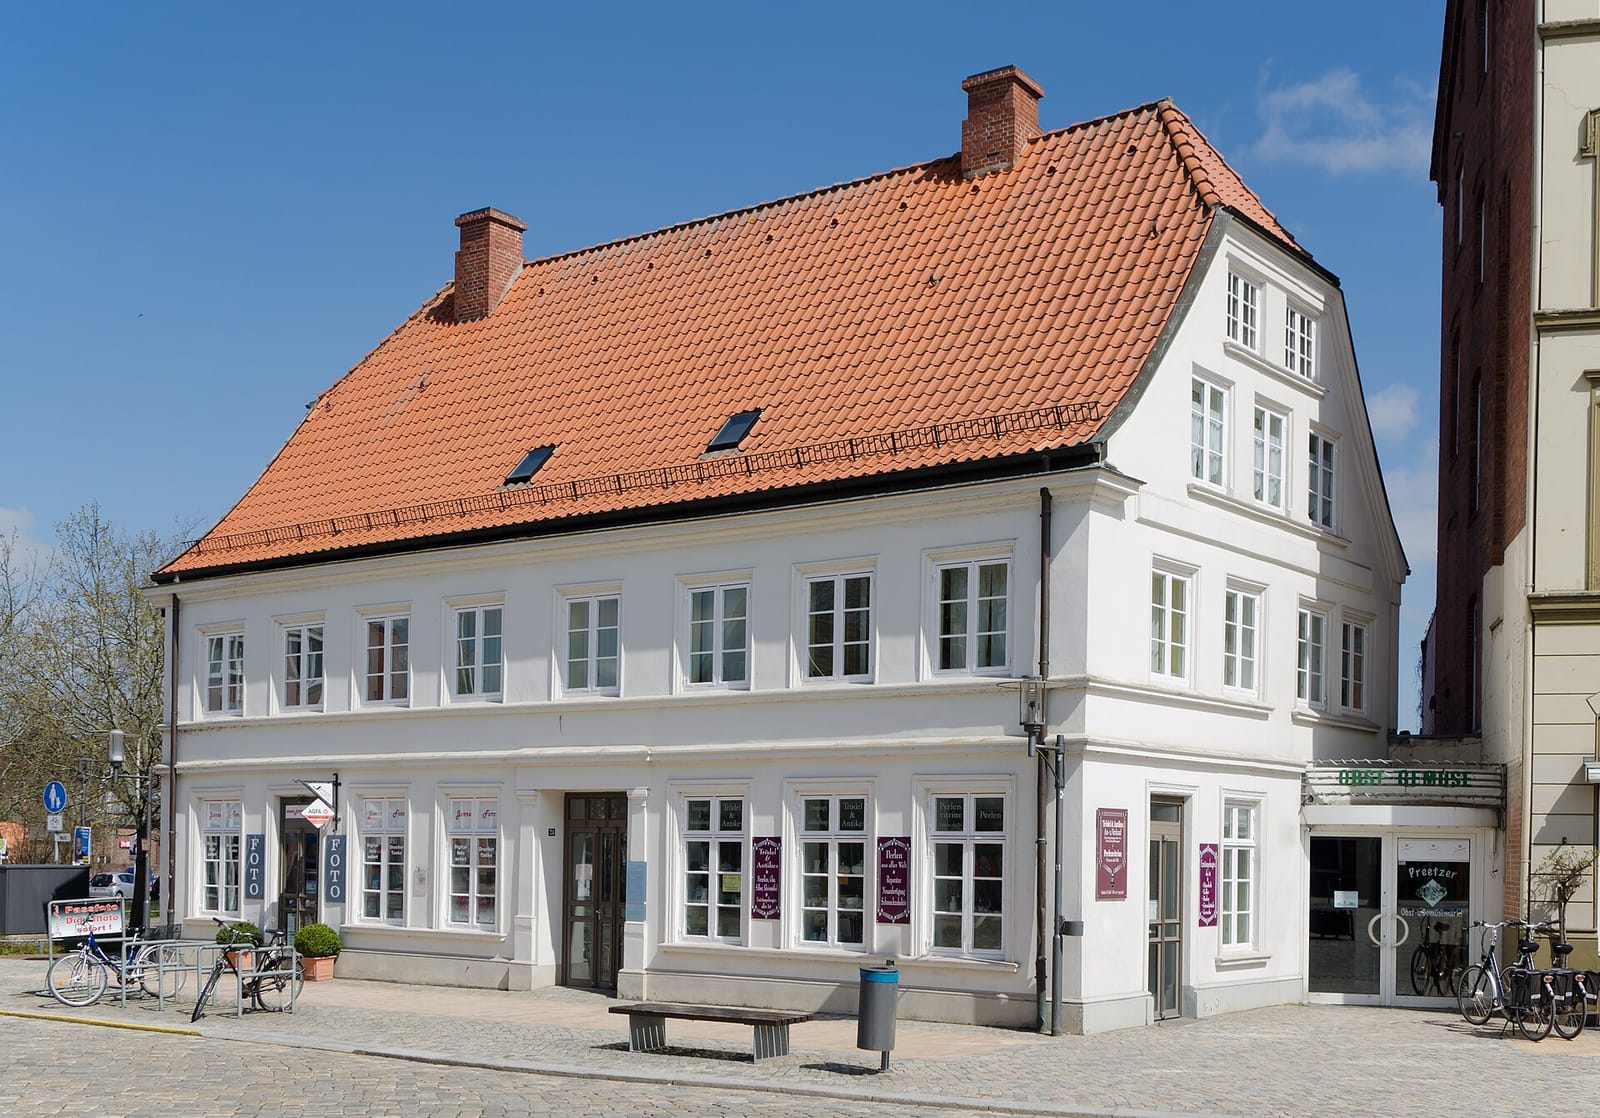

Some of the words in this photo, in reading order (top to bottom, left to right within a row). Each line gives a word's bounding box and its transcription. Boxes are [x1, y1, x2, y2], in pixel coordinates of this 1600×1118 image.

[886, 849, 903, 859] Perlen
[250, 838, 260, 896] FOTO
[330, 838, 341, 898] FOTO
[1408, 867, 1458, 879] Preetzer
[64, 903, 119, 914] Passfoto
[76, 925, 106, 933] sofort
